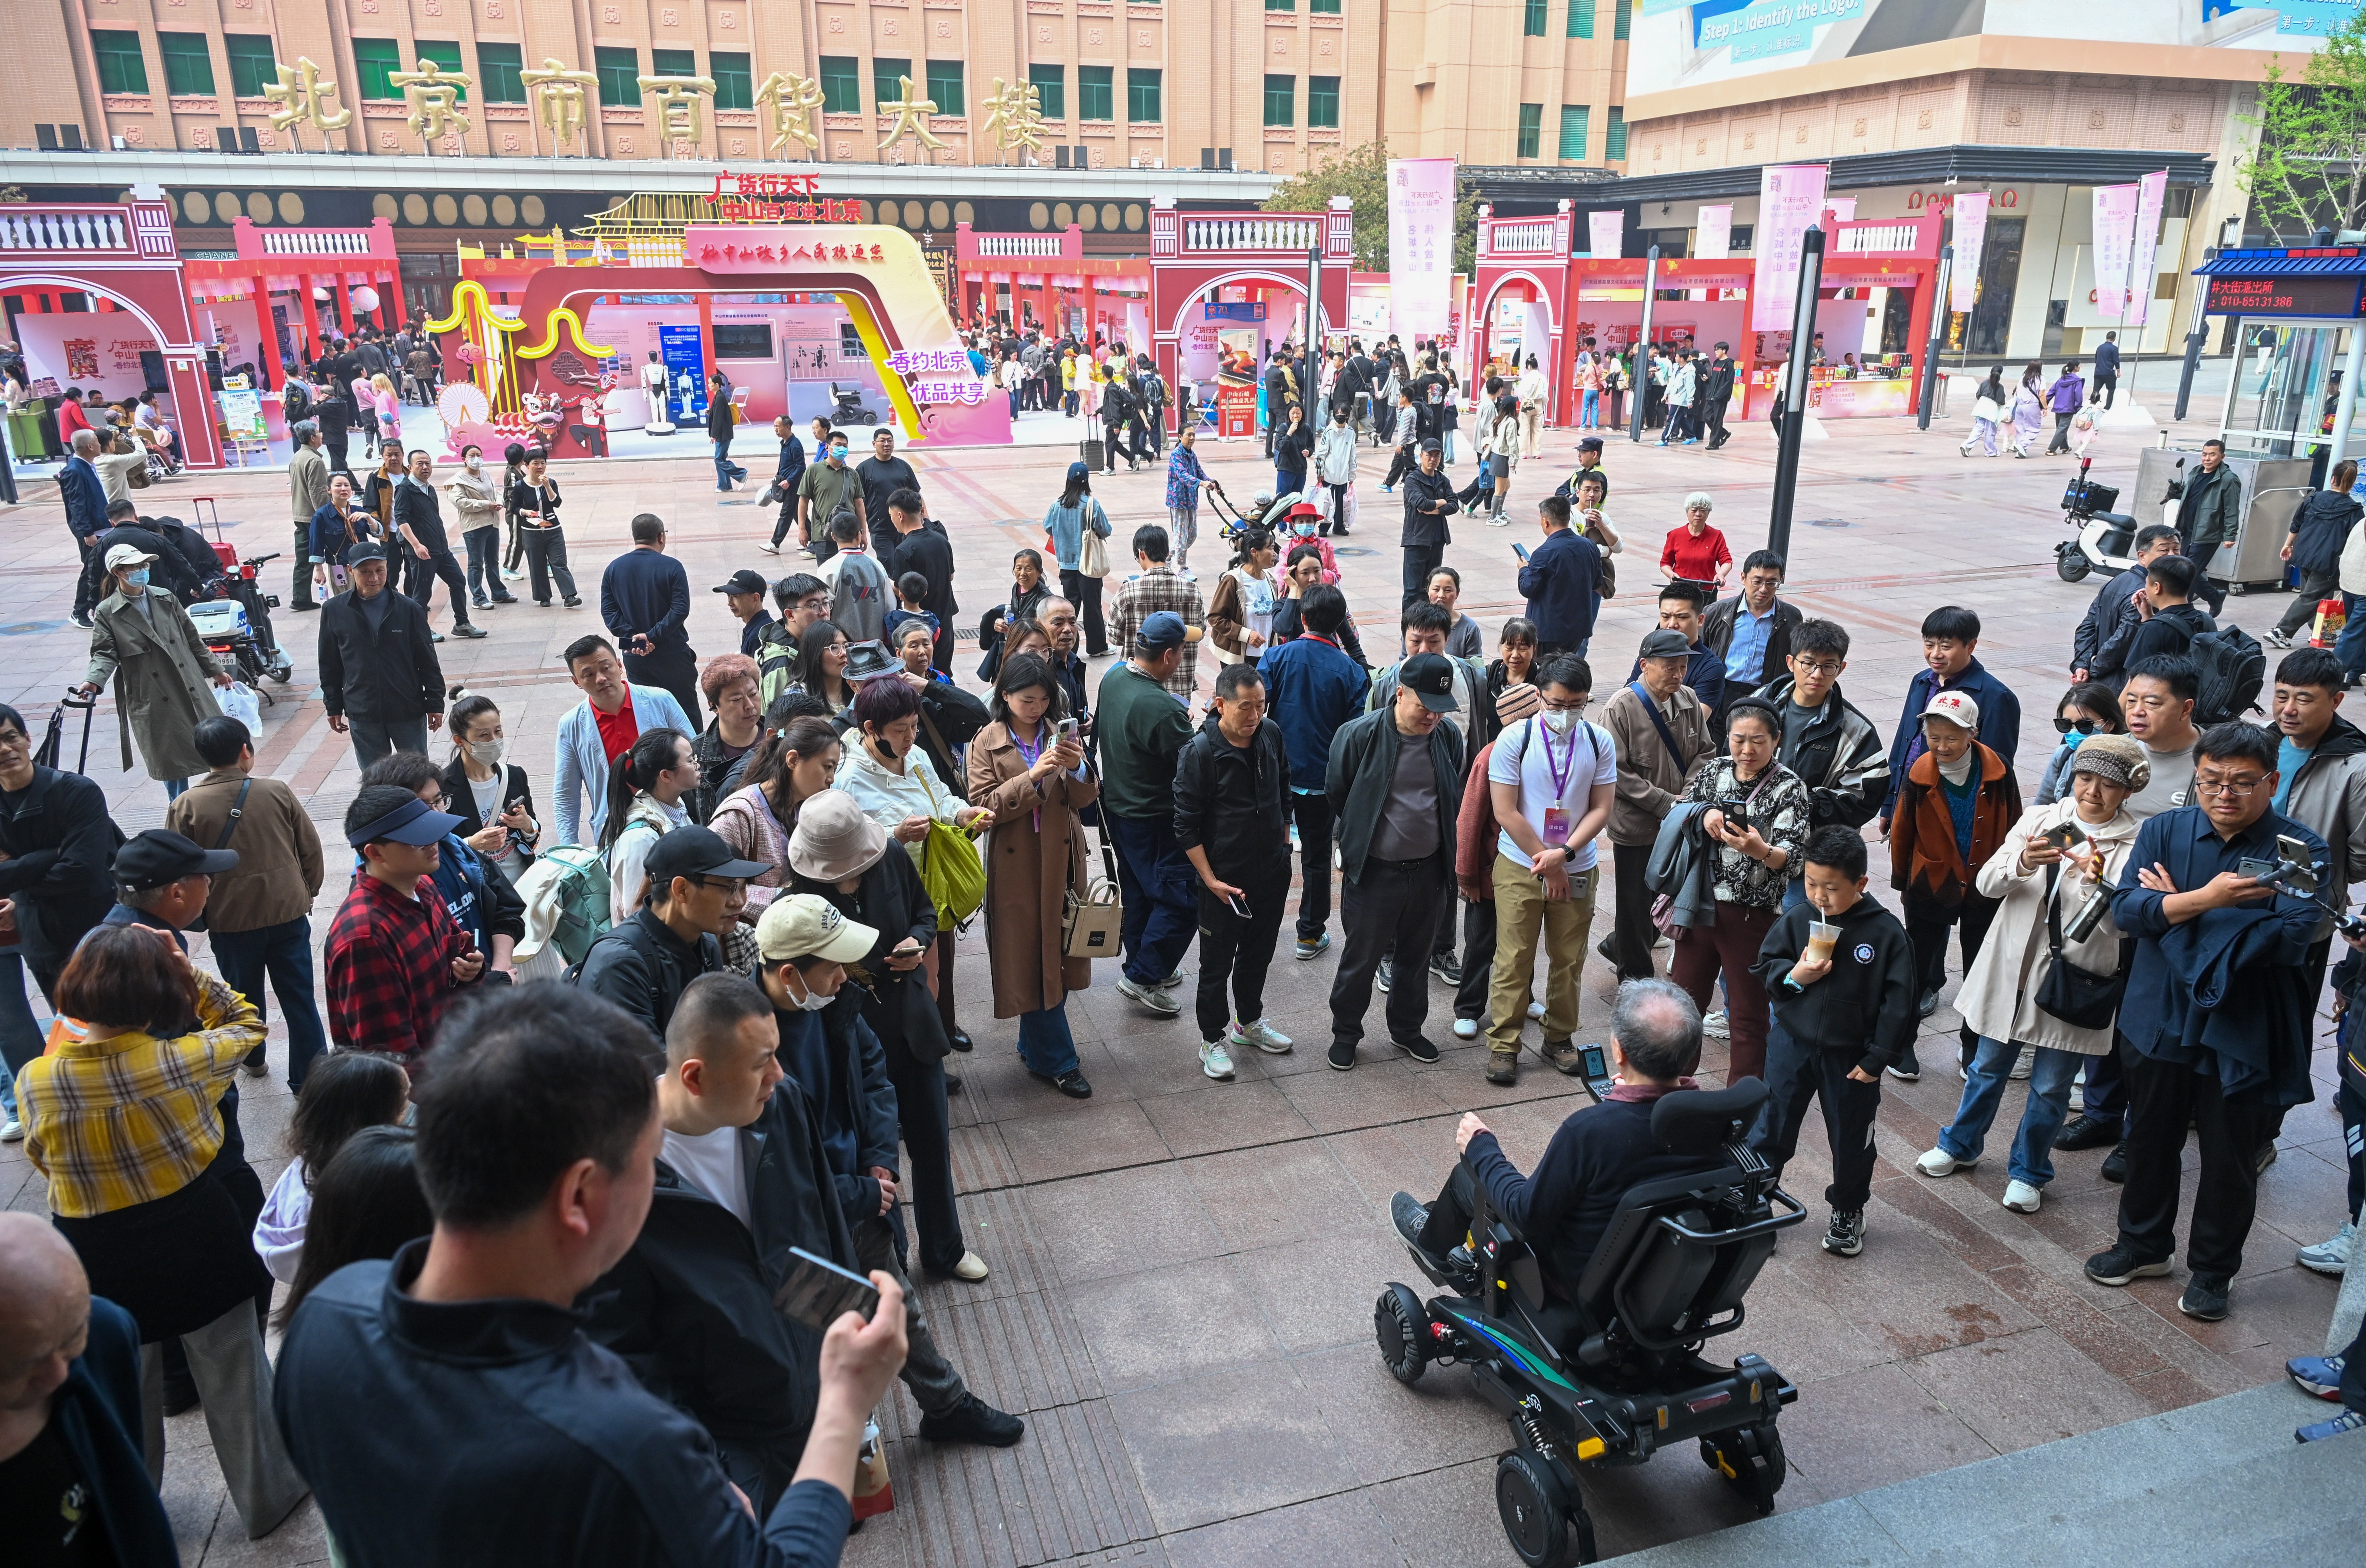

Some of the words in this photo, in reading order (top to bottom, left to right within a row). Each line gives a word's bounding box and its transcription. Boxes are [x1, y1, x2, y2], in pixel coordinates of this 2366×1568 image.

[1704, 24, 1730, 41] Step
[1732, 20, 1743, 35] 1:
[1746, 7, 1795, 33] Identify
[1797, 3, 1817, 21] the
[702, 170, 820, 204] 广货行天下
[722, 197, 864, 224] 中山百货进北京
[700, 242, 884, 262] 孙中山故乡人民欢迎您
[2221, 296, 2293, 307] 010-65131386
[887, 350, 966, 373] 香约北京
[910, 382, 984, 403] 优品共享
[1938, 696, 1961, 707] 北京
